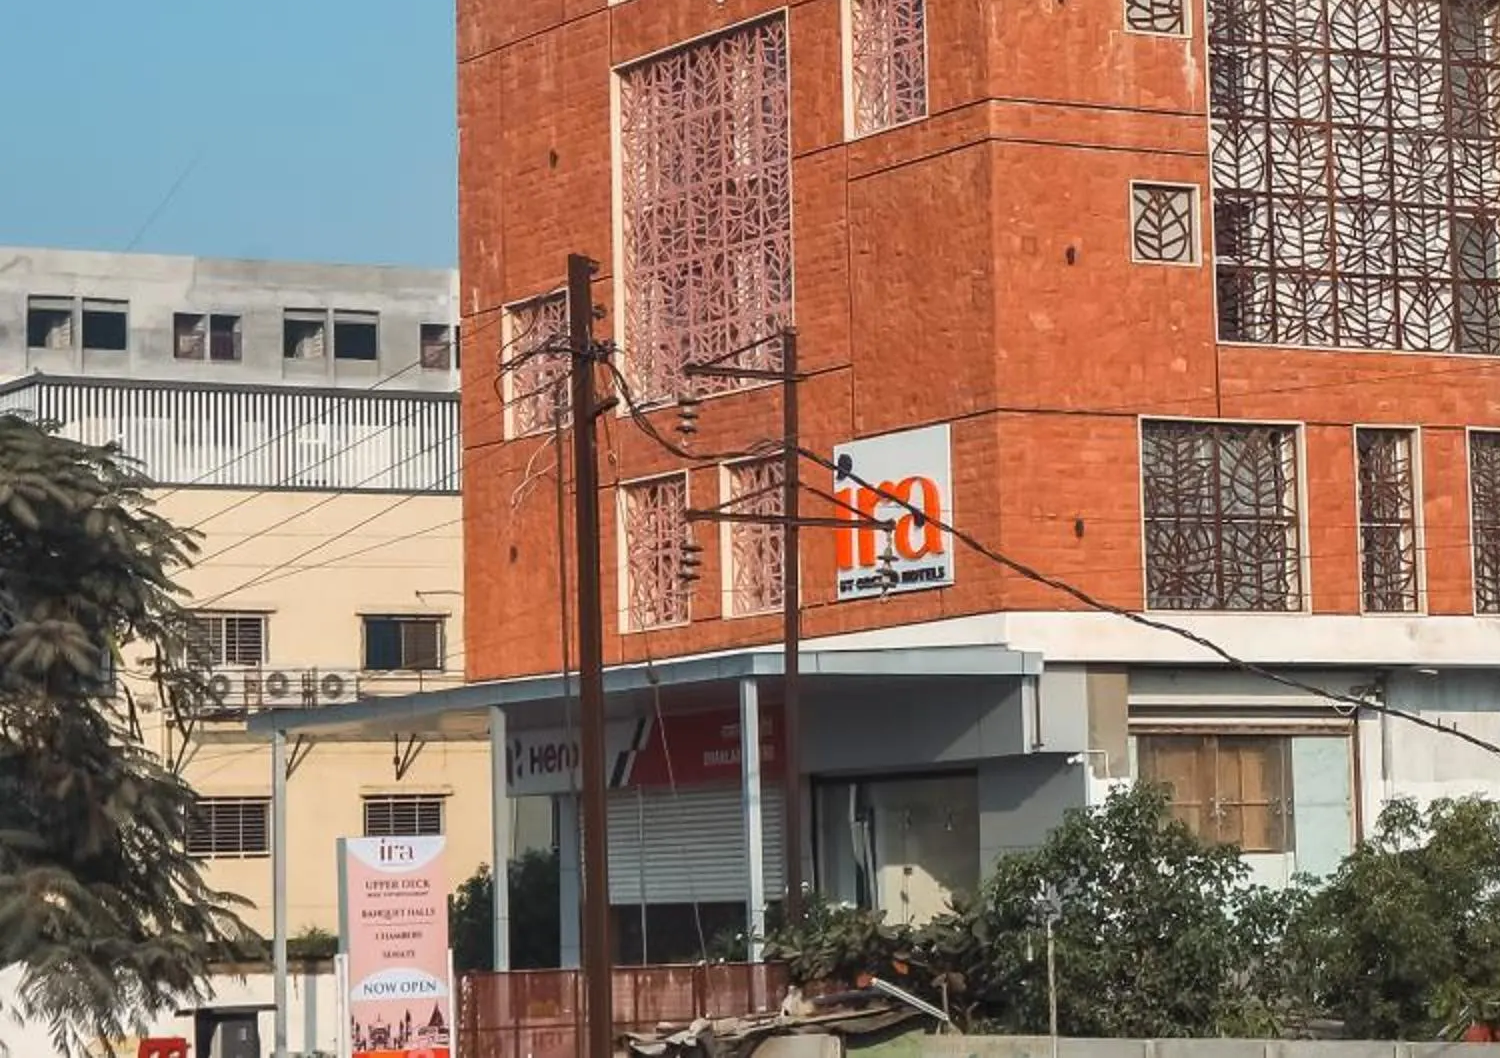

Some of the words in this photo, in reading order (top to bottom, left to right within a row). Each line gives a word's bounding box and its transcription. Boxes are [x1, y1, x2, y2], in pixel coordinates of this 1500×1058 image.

[835, 453, 944, 570] ira
[902, 566, 945, 582] HOTELS
[379, 838, 414, 862] ira
[365, 880, 399, 890] UPPER
[401, 879, 431, 888] DECK
[362, 908, 405, 920] BANQUET
[407, 907, 436, 917] HALLS
[375, 931, 423, 940] CHAMBERS
[363, 981, 397, 995] NOW
[400, 980, 437, 993] OPEN
